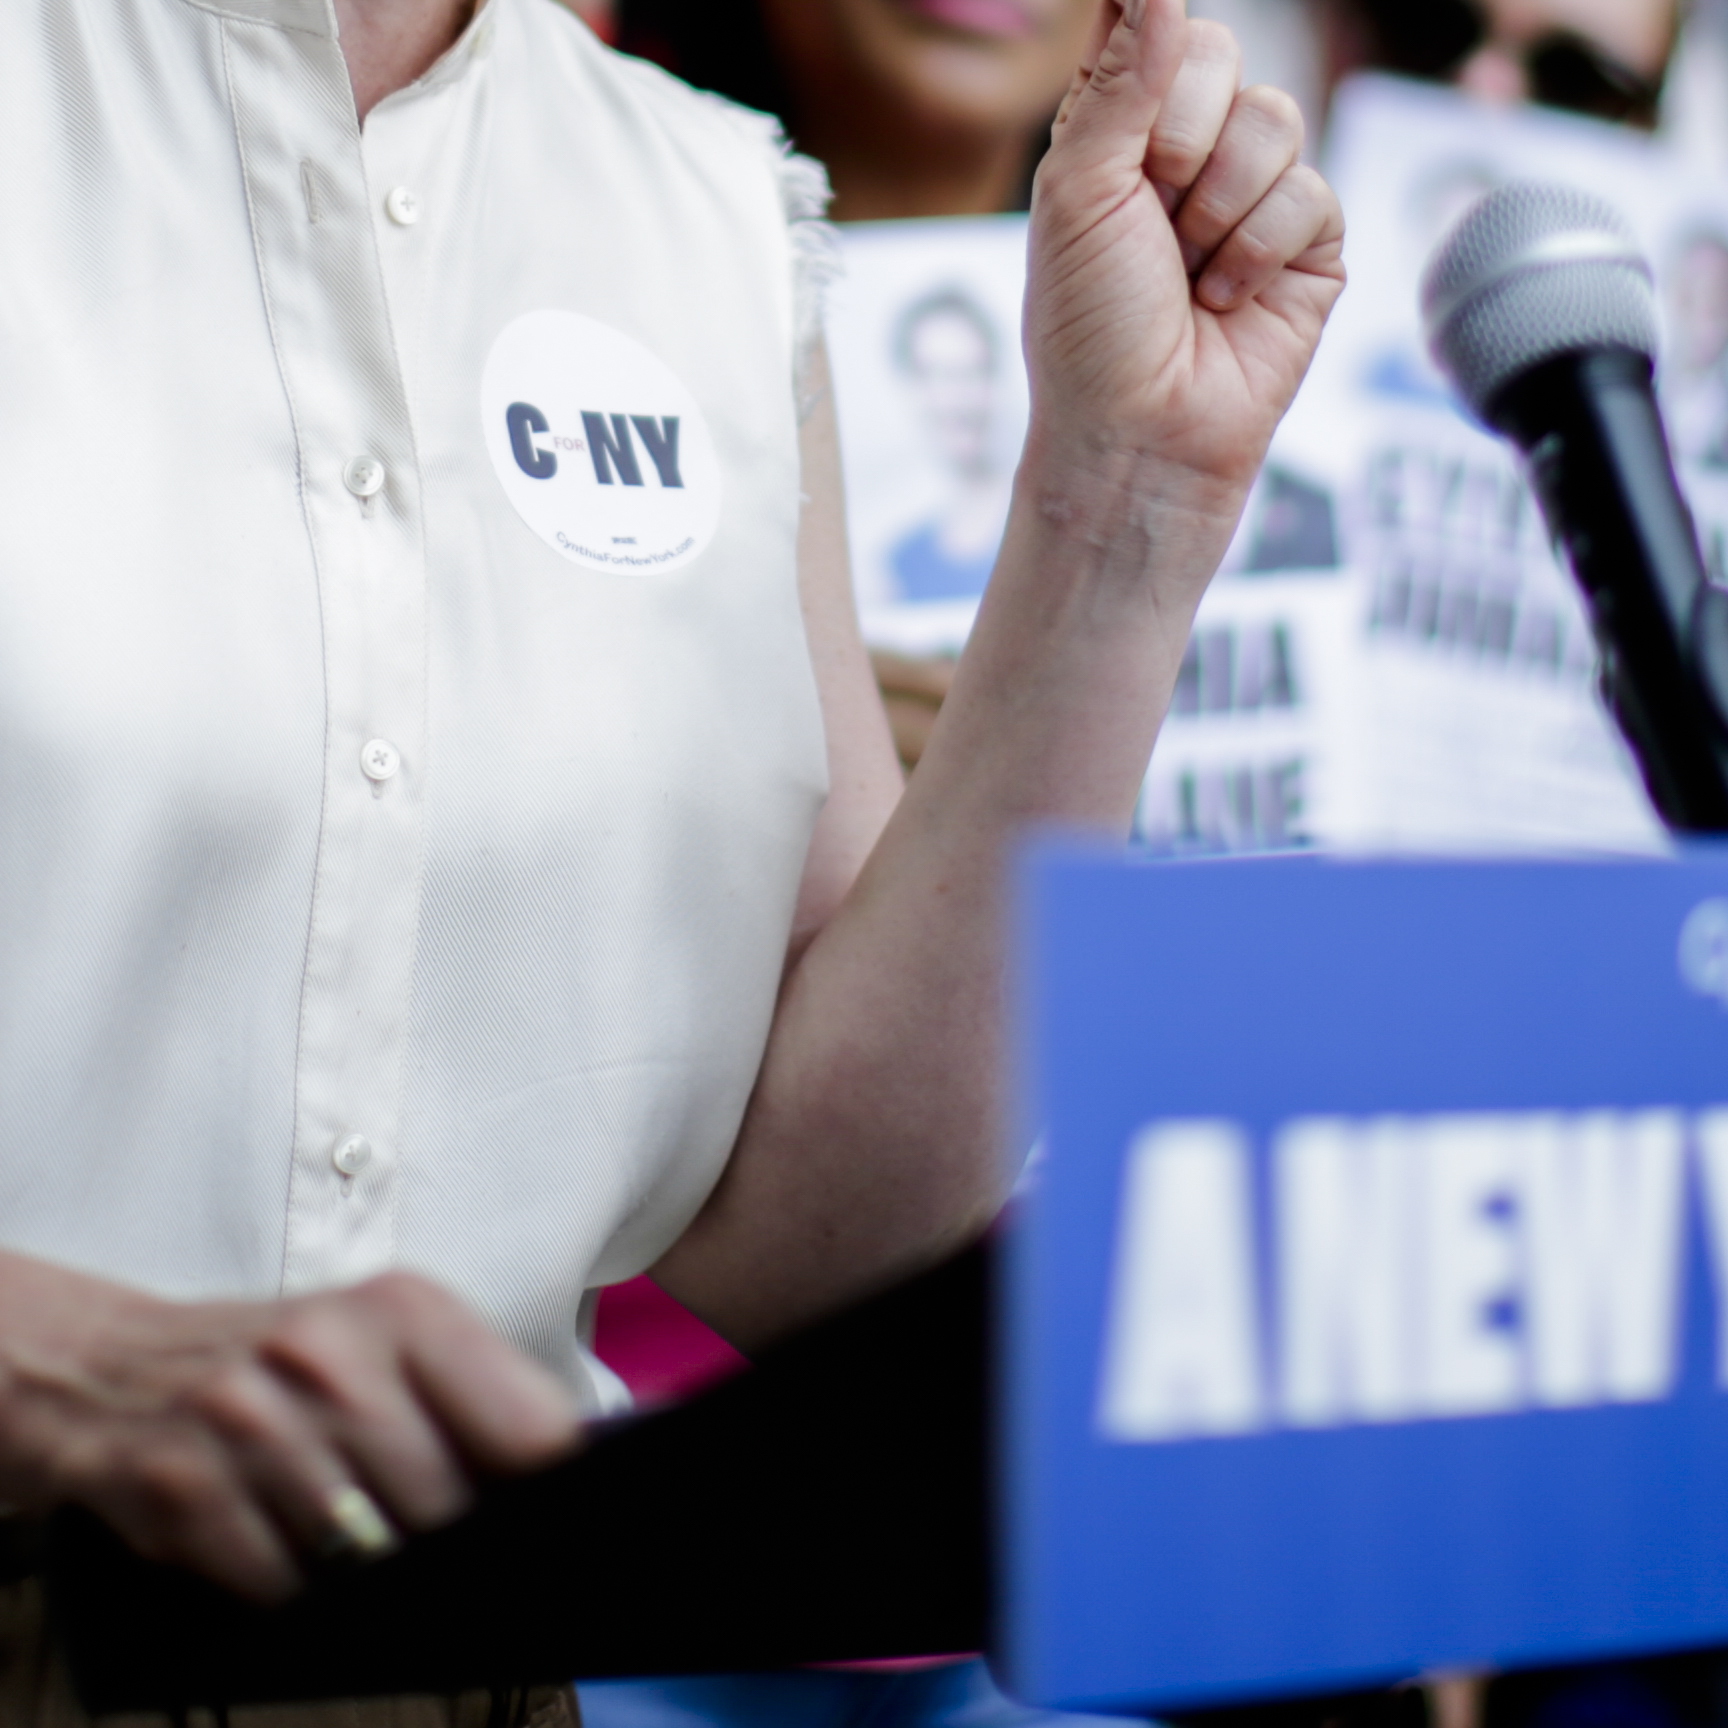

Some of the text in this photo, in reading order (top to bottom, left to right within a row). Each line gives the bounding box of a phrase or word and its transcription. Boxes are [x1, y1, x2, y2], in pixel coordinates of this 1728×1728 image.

[504, 400, 686, 489] C FOR NY
[556, 530, 696, 567] CynthiaForNewYork.com
[1096, 1115, 1270, 1442] A
[1274, 1107, 1684, 1432] NEW
